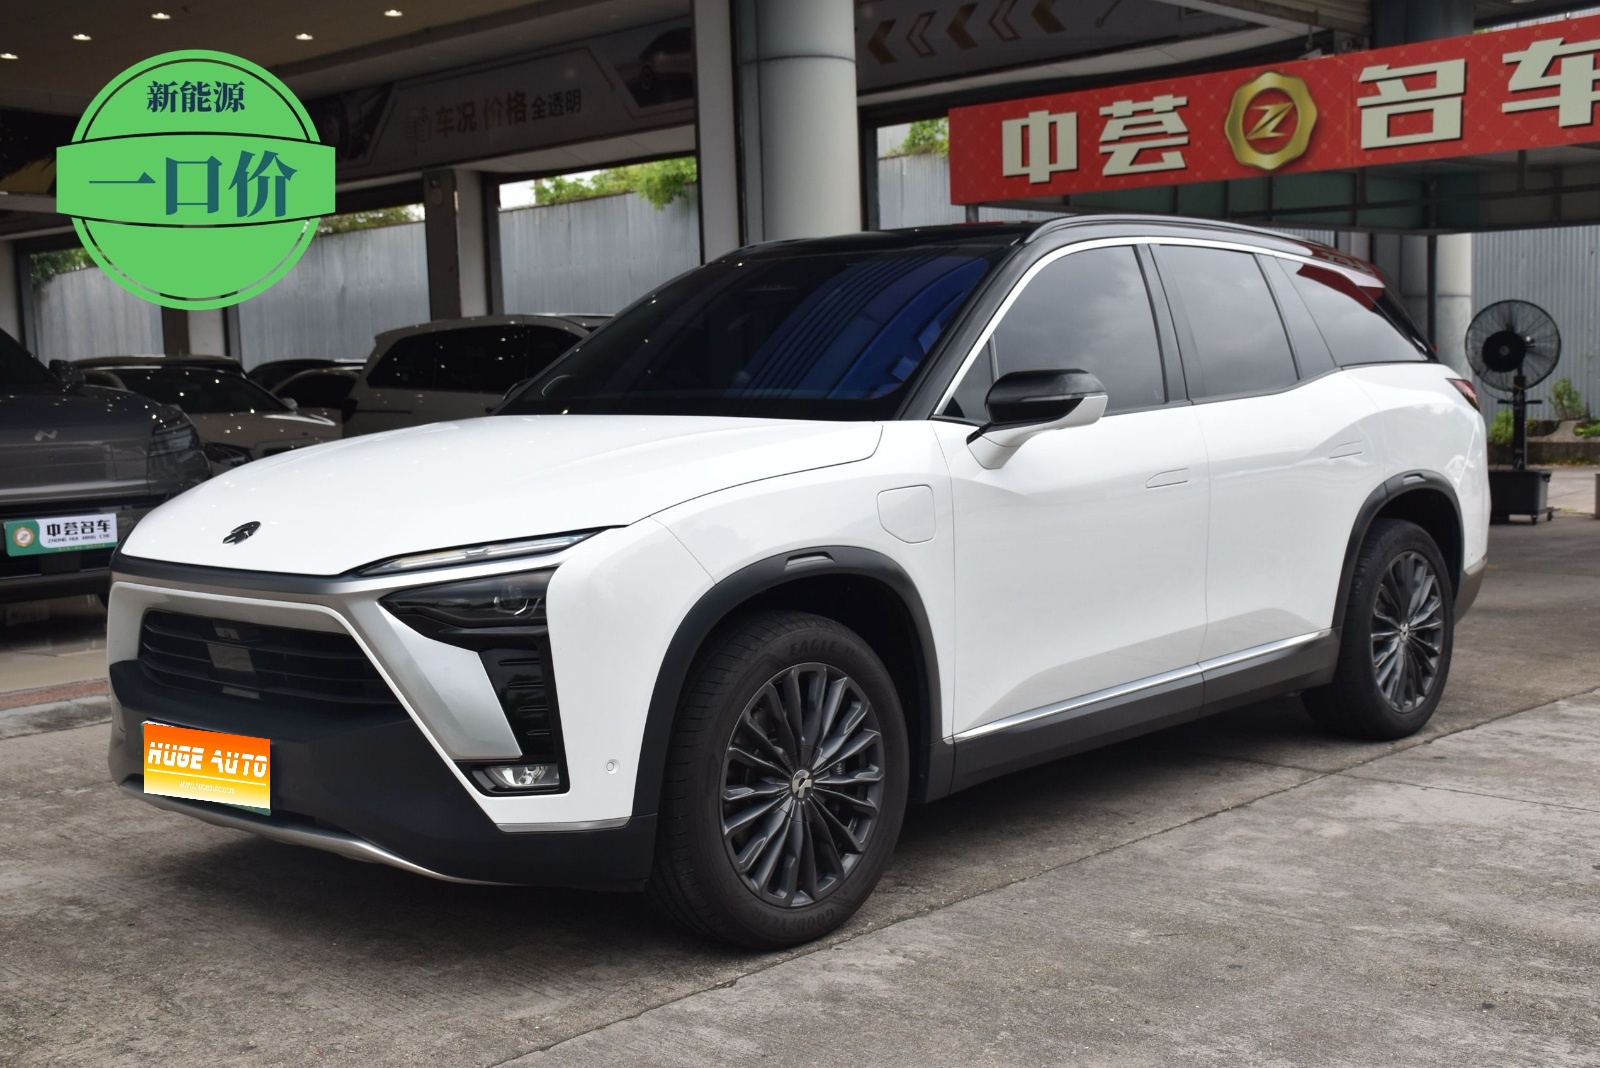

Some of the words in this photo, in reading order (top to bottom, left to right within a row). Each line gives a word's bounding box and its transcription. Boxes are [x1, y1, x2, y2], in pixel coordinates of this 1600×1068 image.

[435, 101, 477, 137] 车况
[532, 88, 582, 121] 全透明
[1001, 94, 1189, 184] 中荟
[1357, 37, 1600, 150] 名车
[46, 519, 111, 537] 中荟名车
